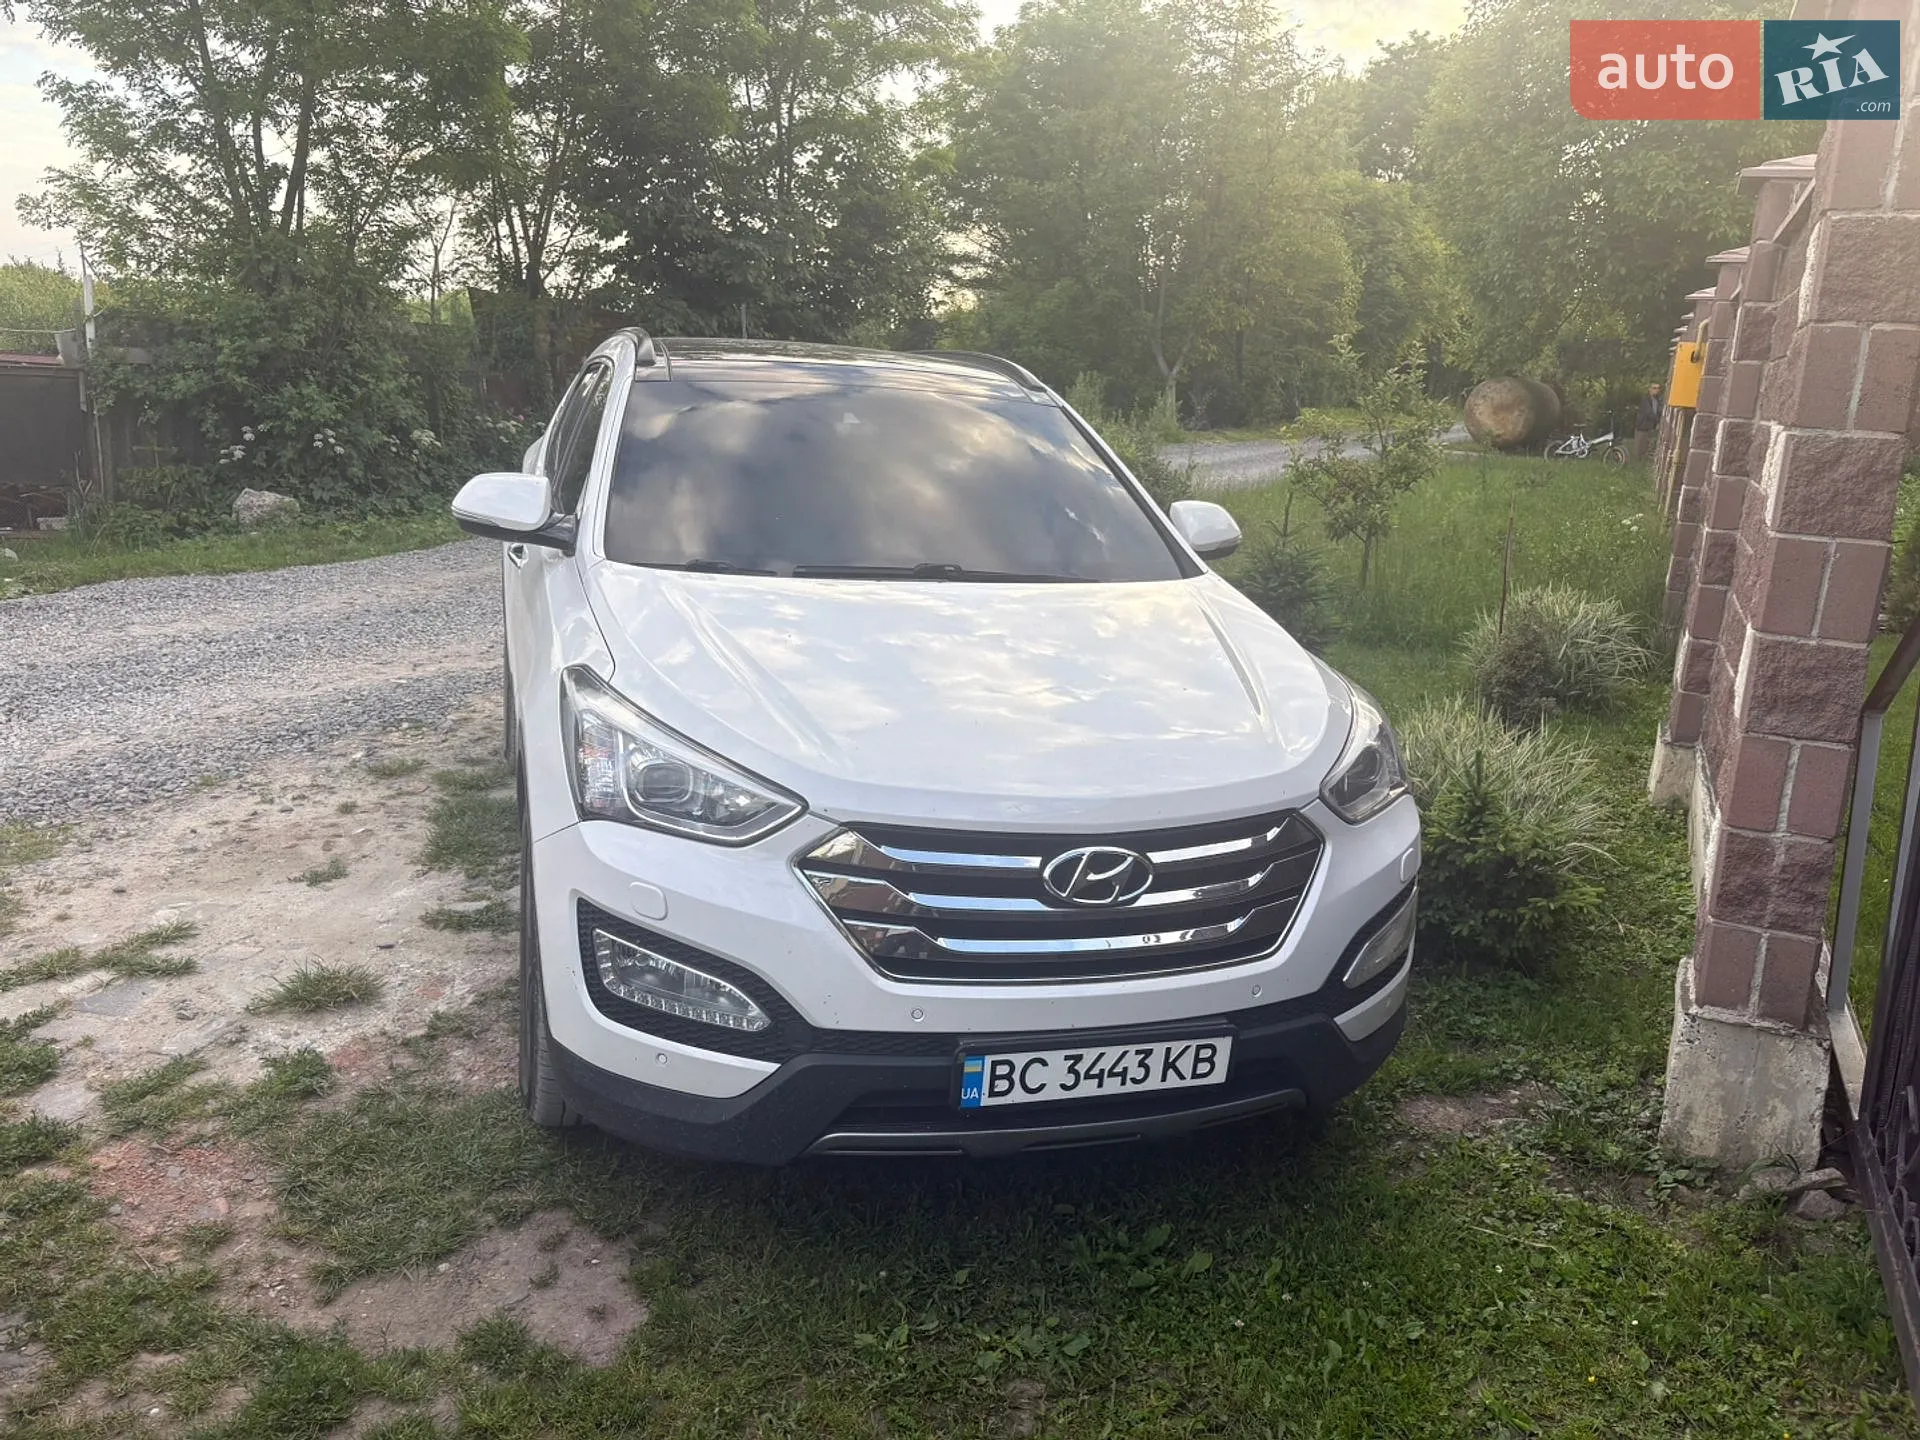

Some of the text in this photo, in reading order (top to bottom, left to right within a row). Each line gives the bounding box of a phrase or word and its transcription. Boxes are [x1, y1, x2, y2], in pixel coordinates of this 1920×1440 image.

[987, 1042, 1218, 1099] BC 3443 KB
[961, 1086, 980, 1101] UA
